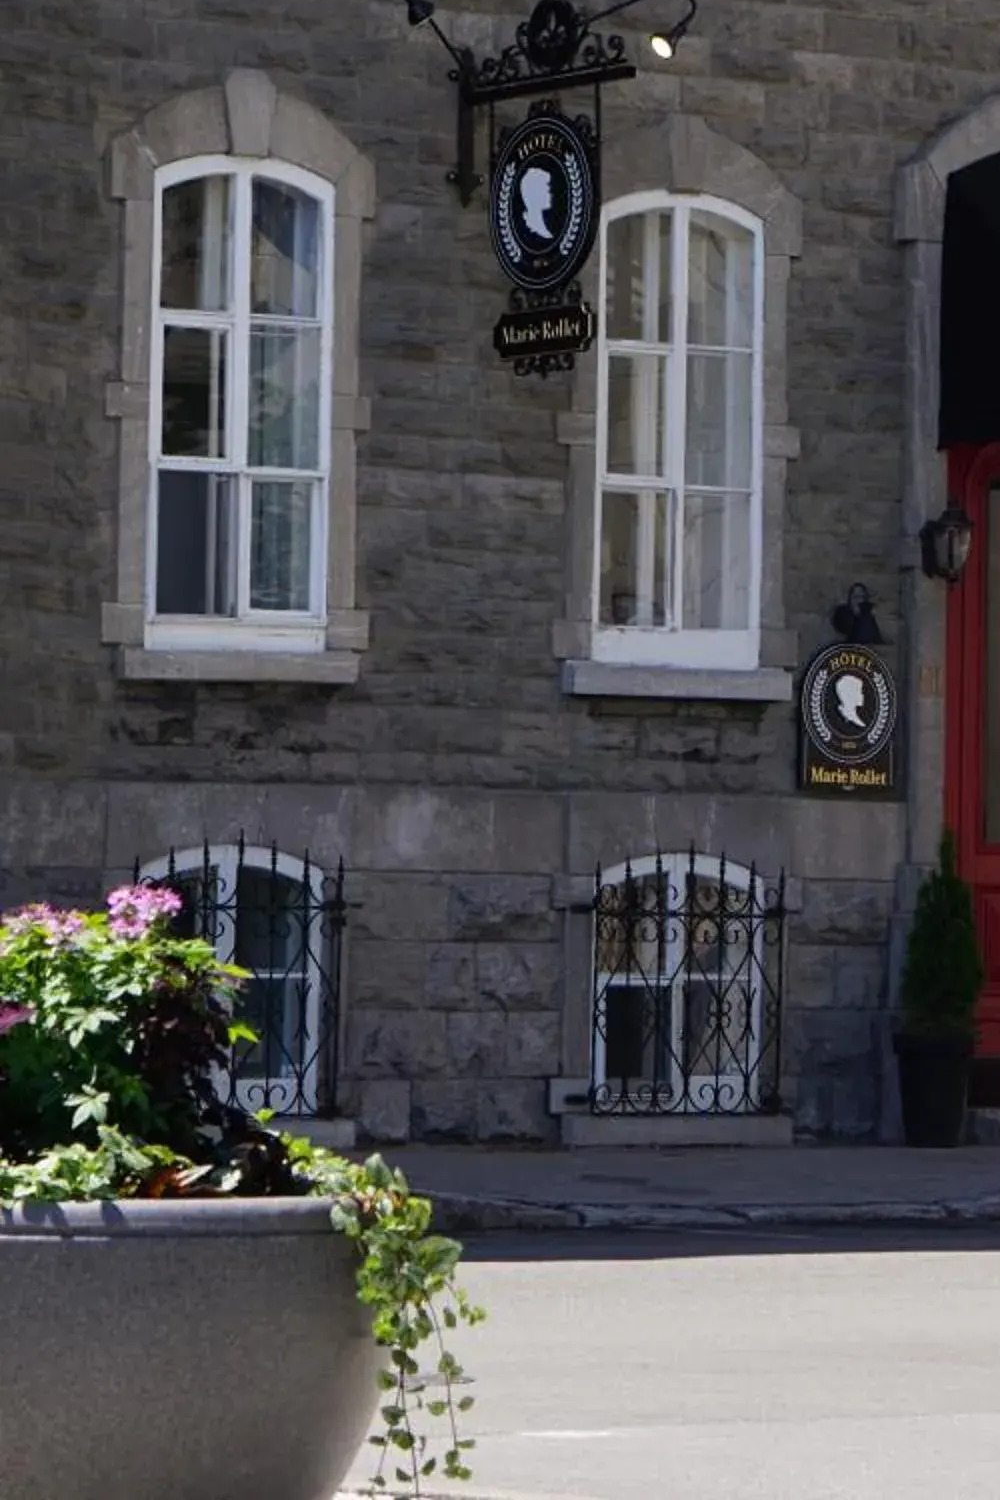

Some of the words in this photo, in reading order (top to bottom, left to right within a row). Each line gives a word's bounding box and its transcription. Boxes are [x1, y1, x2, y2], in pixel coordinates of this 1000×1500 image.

[503, 323, 541, 345] Marie
[542, 317, 580, 340] Rollet
[811, 765, 848, 783] Marie
[850, 767, 886, 785] Rollet
